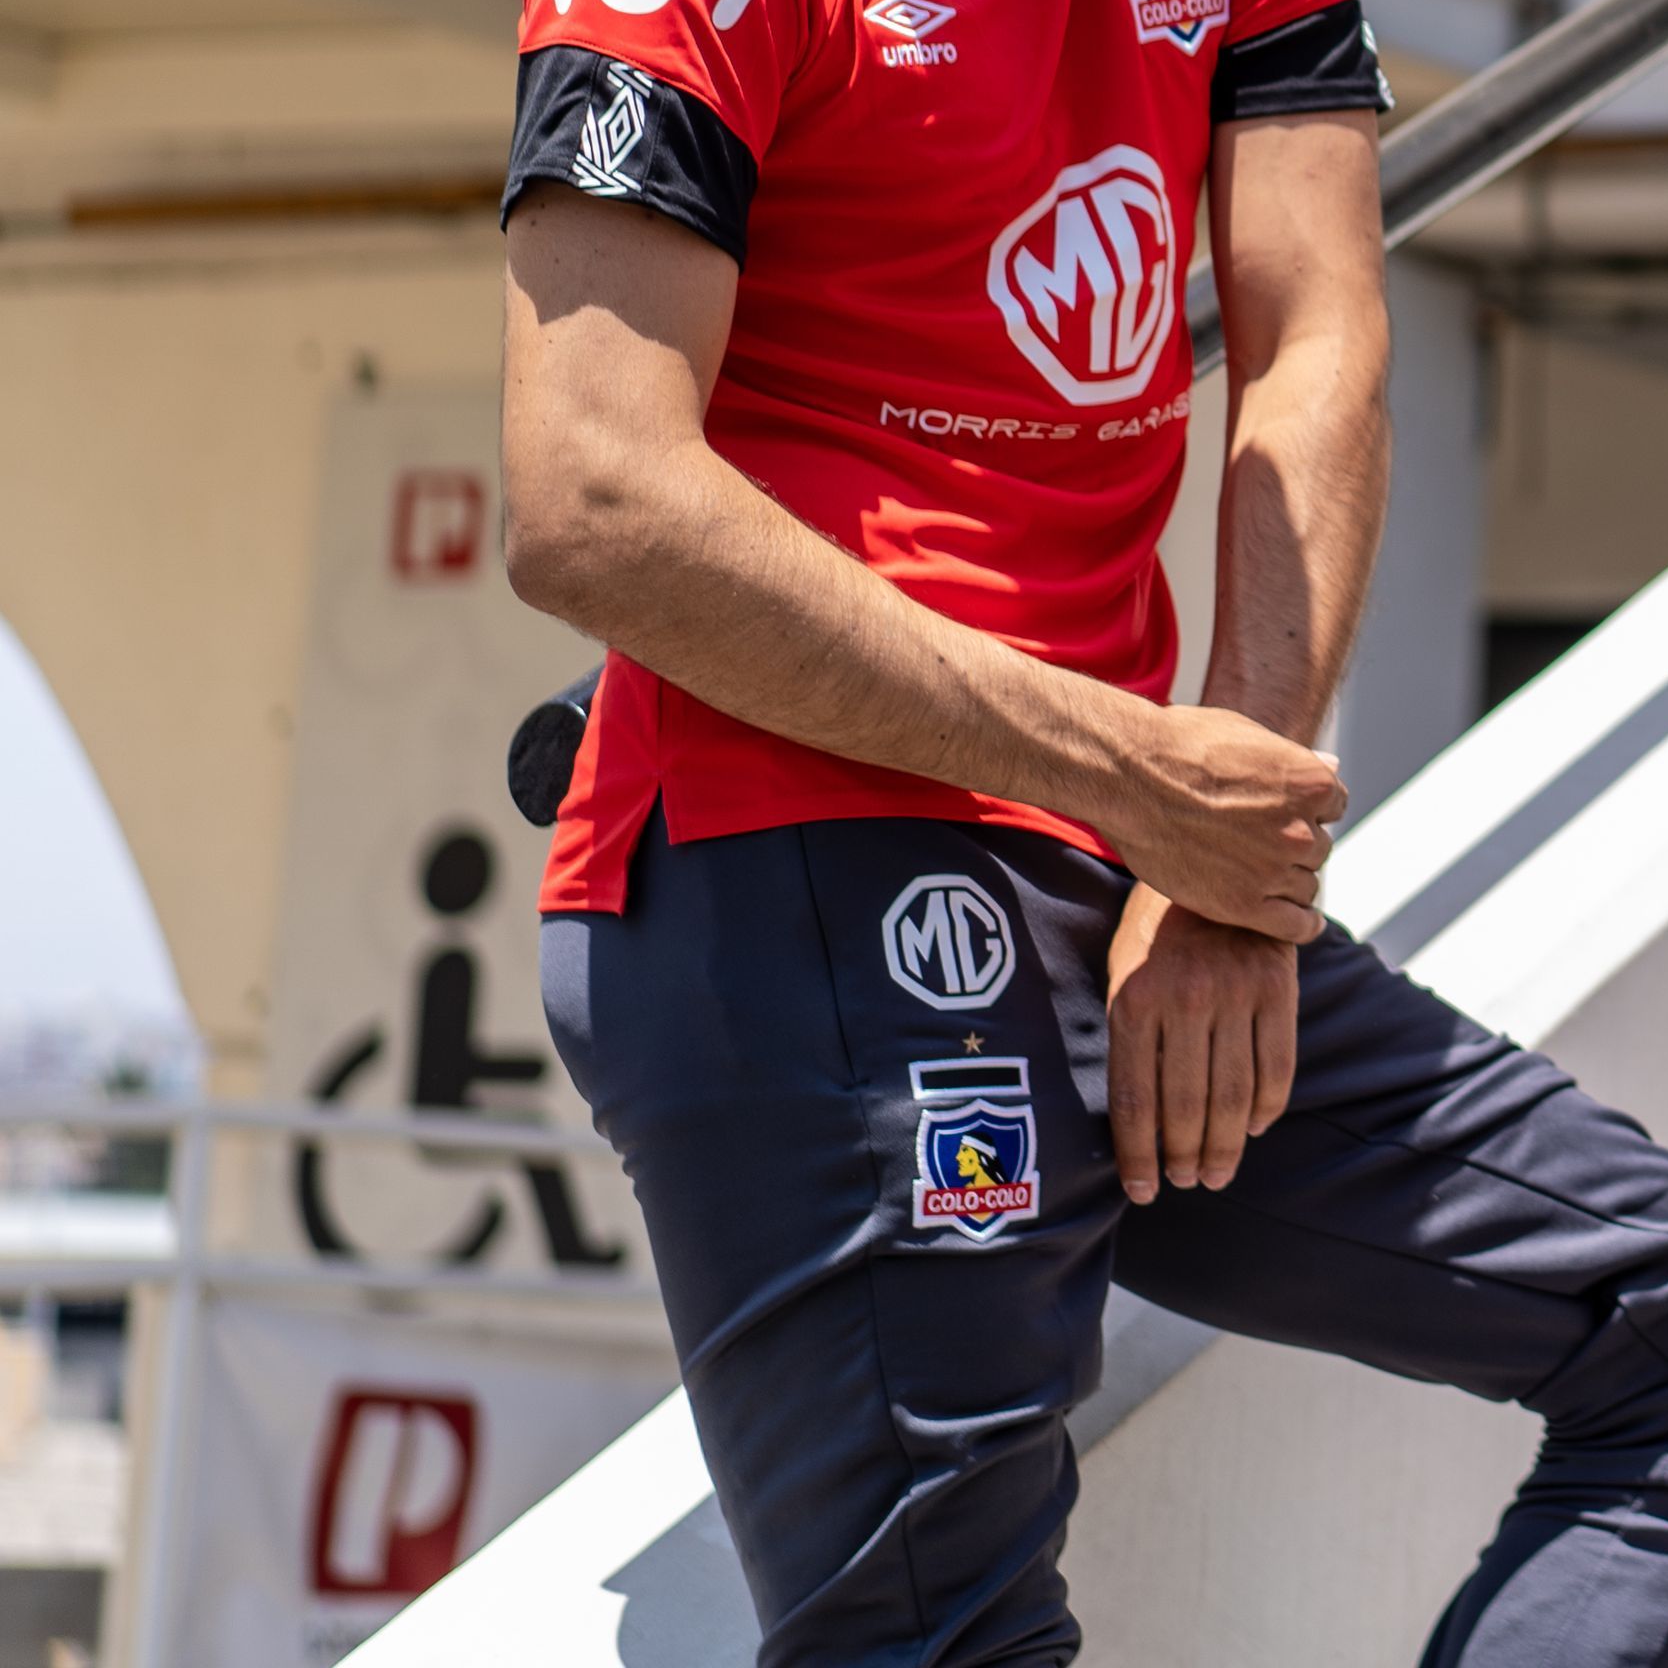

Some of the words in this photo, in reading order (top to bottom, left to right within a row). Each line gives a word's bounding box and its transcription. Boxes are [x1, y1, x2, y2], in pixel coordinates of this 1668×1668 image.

[882, 39, 958, 68] umbro
[1013, 178, 1167, 374] MG
[880, 401, 1082, 440] MORRIS
[1097, 391, 1190, 441] GARAG
[900, 890, 1001, 994] MG
[928, 1185, 1029, 1213] COLO-COLO
